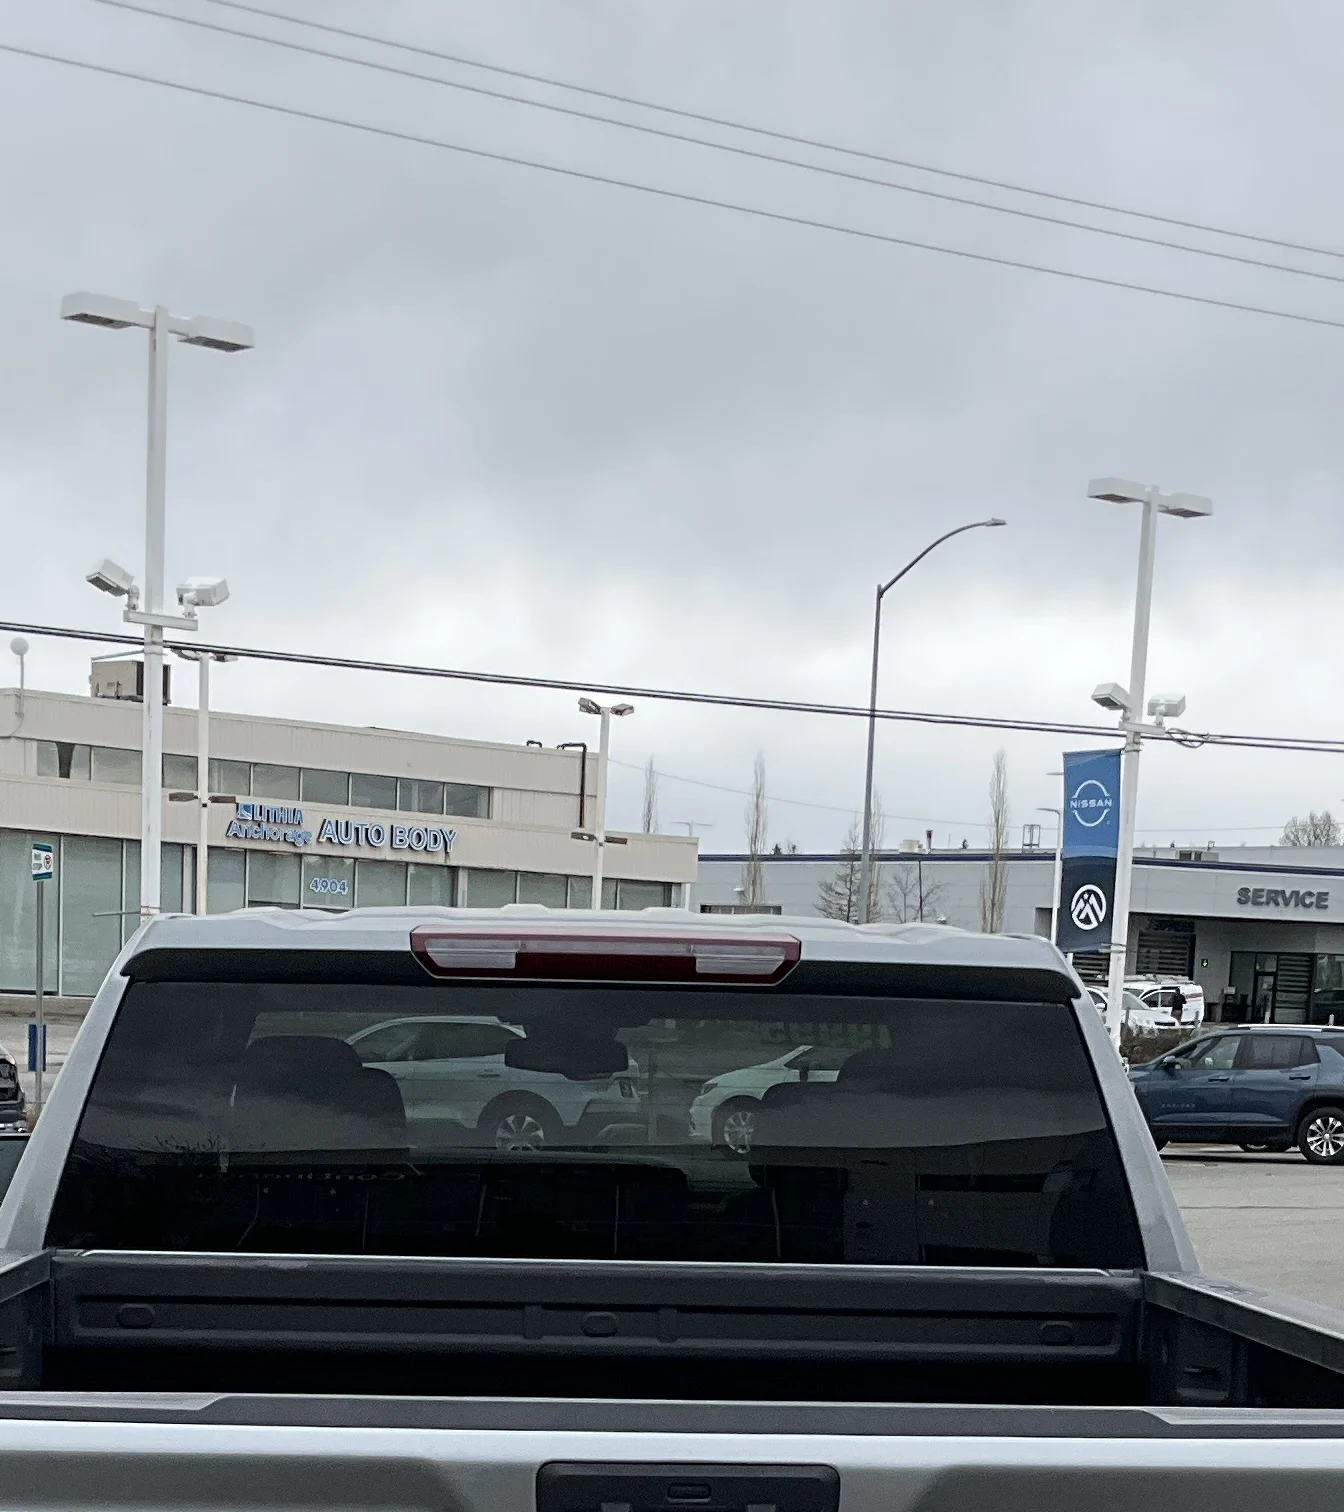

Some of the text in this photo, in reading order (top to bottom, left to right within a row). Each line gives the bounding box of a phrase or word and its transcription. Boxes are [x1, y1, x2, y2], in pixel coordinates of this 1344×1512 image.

[253, 803, 304, 825] LITHIA
[1069, 798, 1113, 809] NISSAN
[226, 820, 313, 847] Anchorage
[318, 817, 458, 853] AUTO BODY
[309, 878, 349, 896] 4904
[1236, 887, 1330, 910] SERVICE
